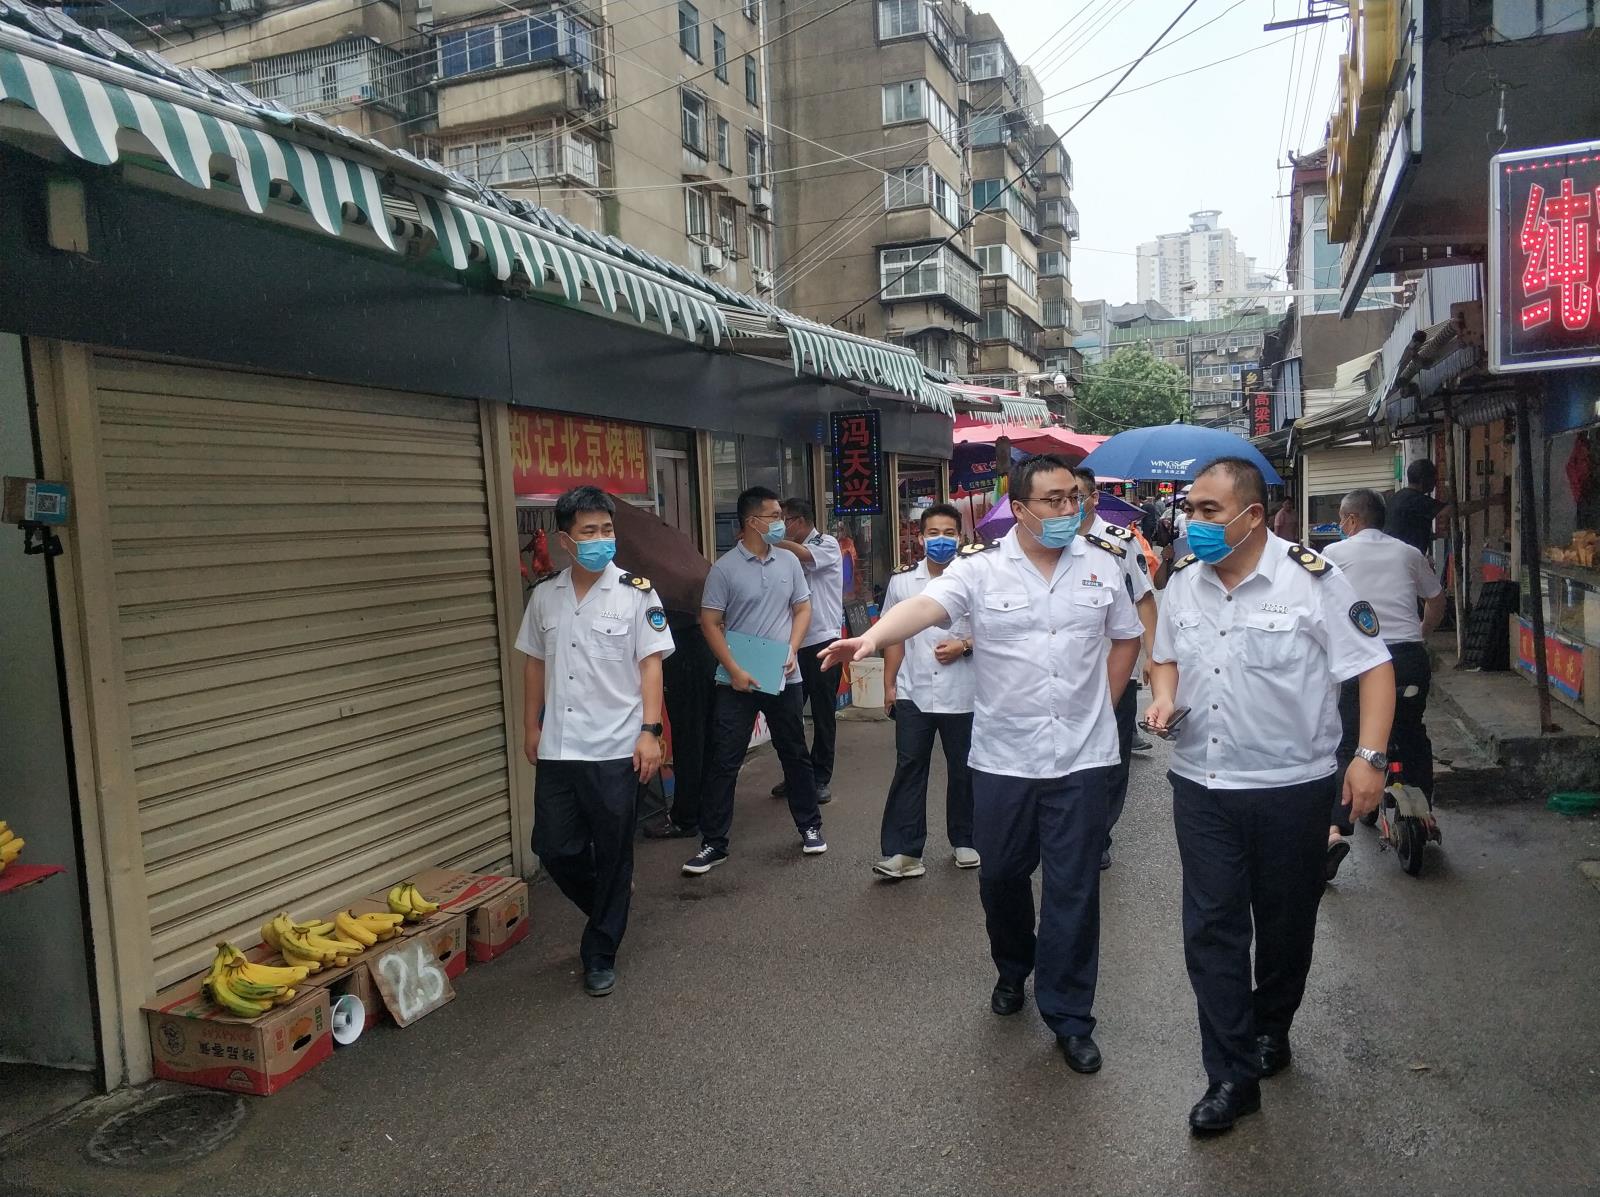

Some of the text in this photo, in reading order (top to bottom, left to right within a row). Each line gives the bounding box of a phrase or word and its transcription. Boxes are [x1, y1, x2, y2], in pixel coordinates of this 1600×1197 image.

[1521, 178, 1600, 331] 纯
[509, 411, 645, 479] 郑记北京烤鸭
[841, 418, 873, 507] 冯天兴
